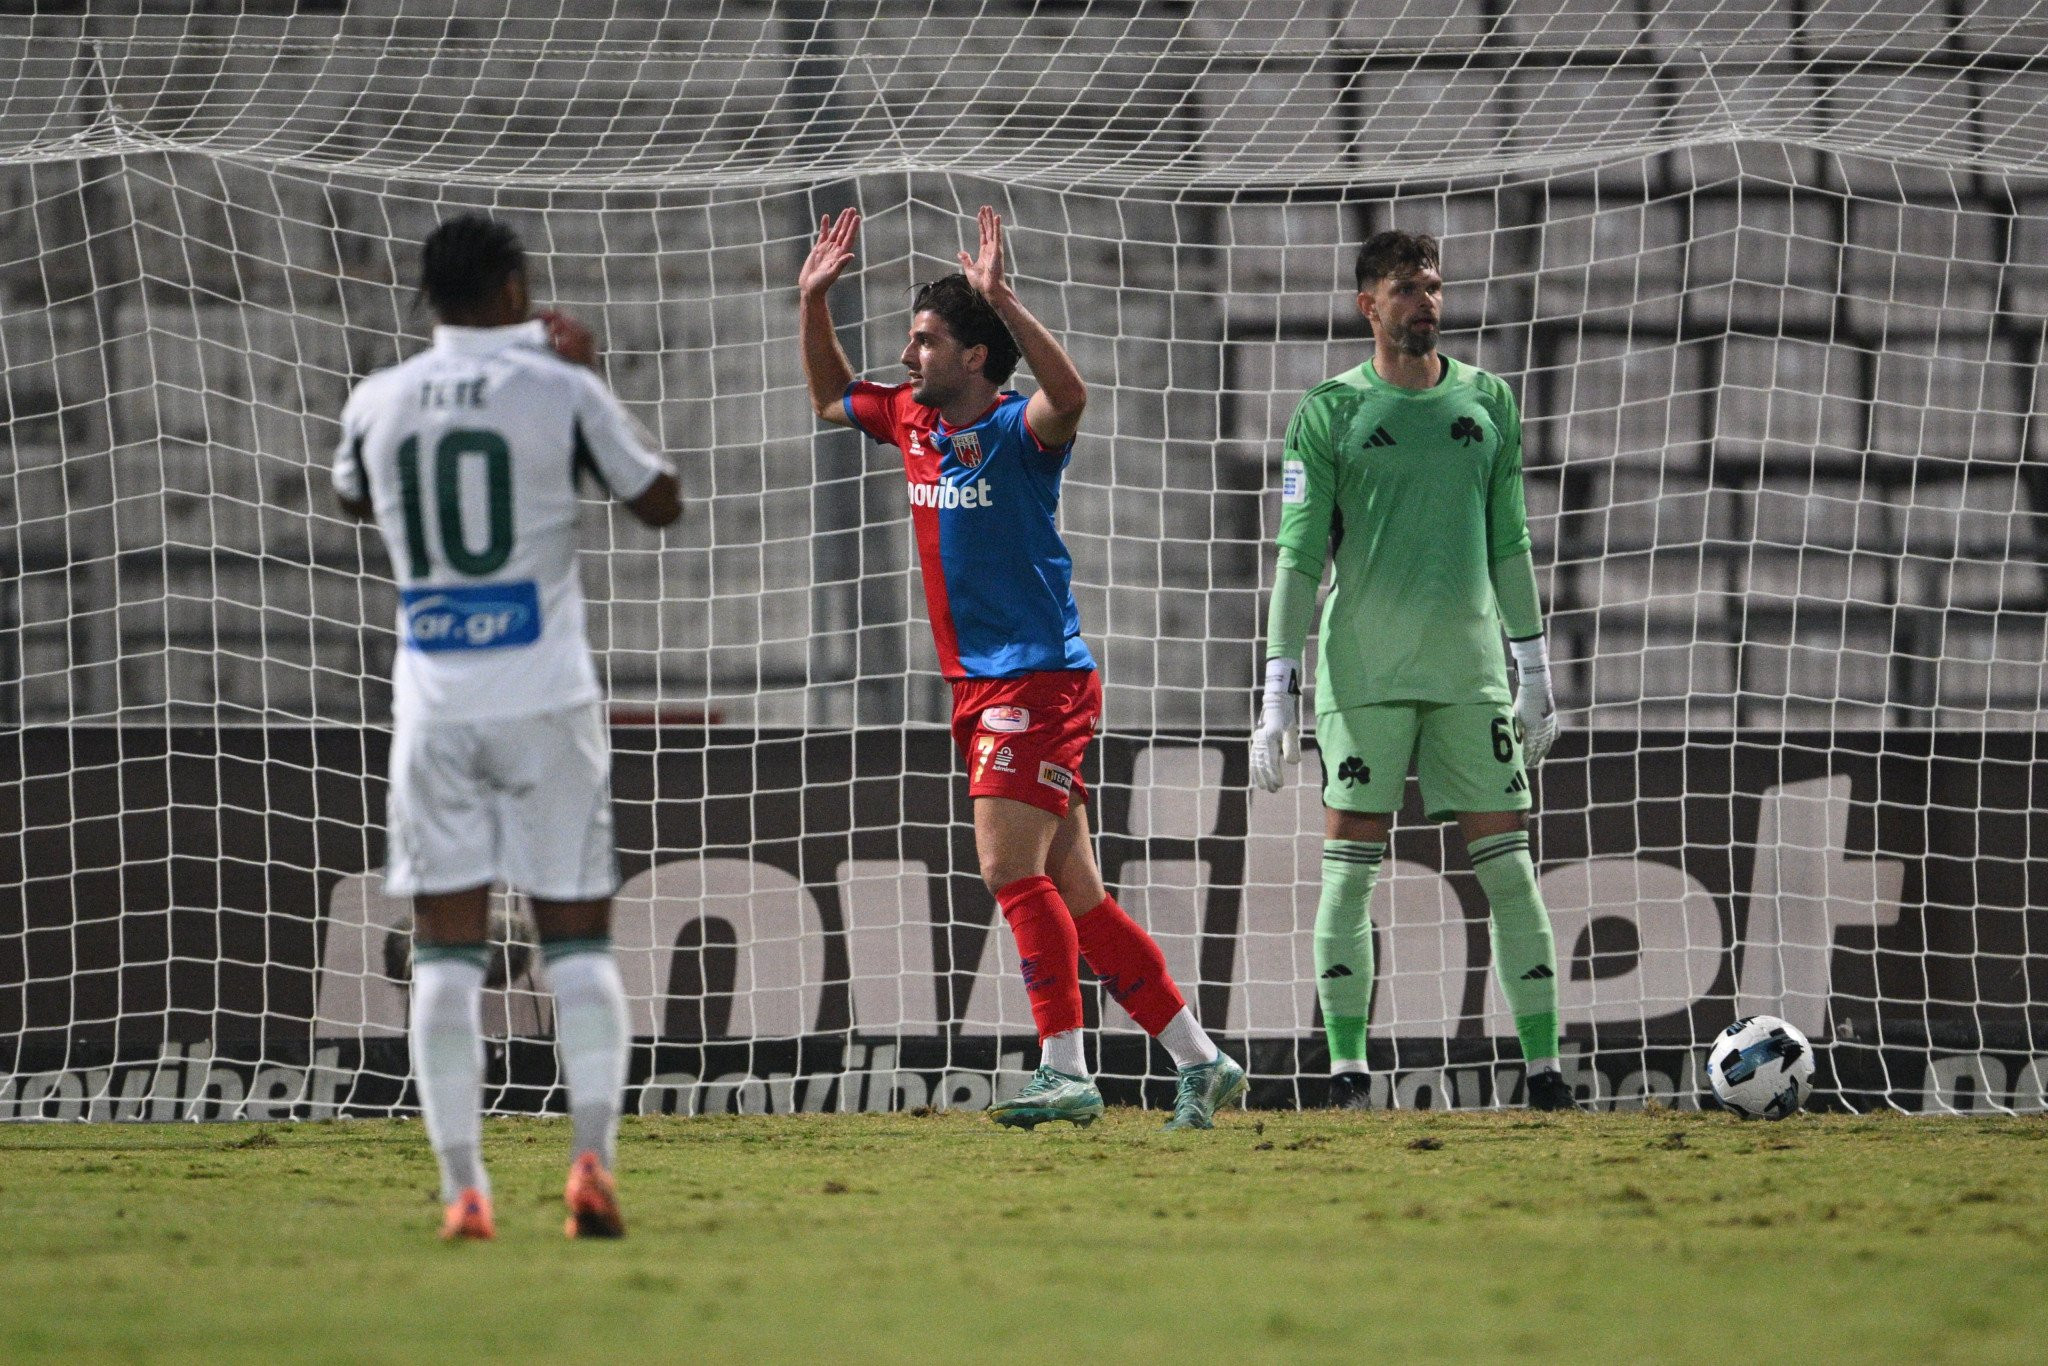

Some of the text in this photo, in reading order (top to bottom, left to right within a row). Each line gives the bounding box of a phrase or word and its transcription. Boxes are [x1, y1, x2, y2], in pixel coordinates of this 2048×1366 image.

[398, 426, 514, 579] 10
[975, 736, 995, 783] 7
[0, 1041, 353, 1121] ovibet
